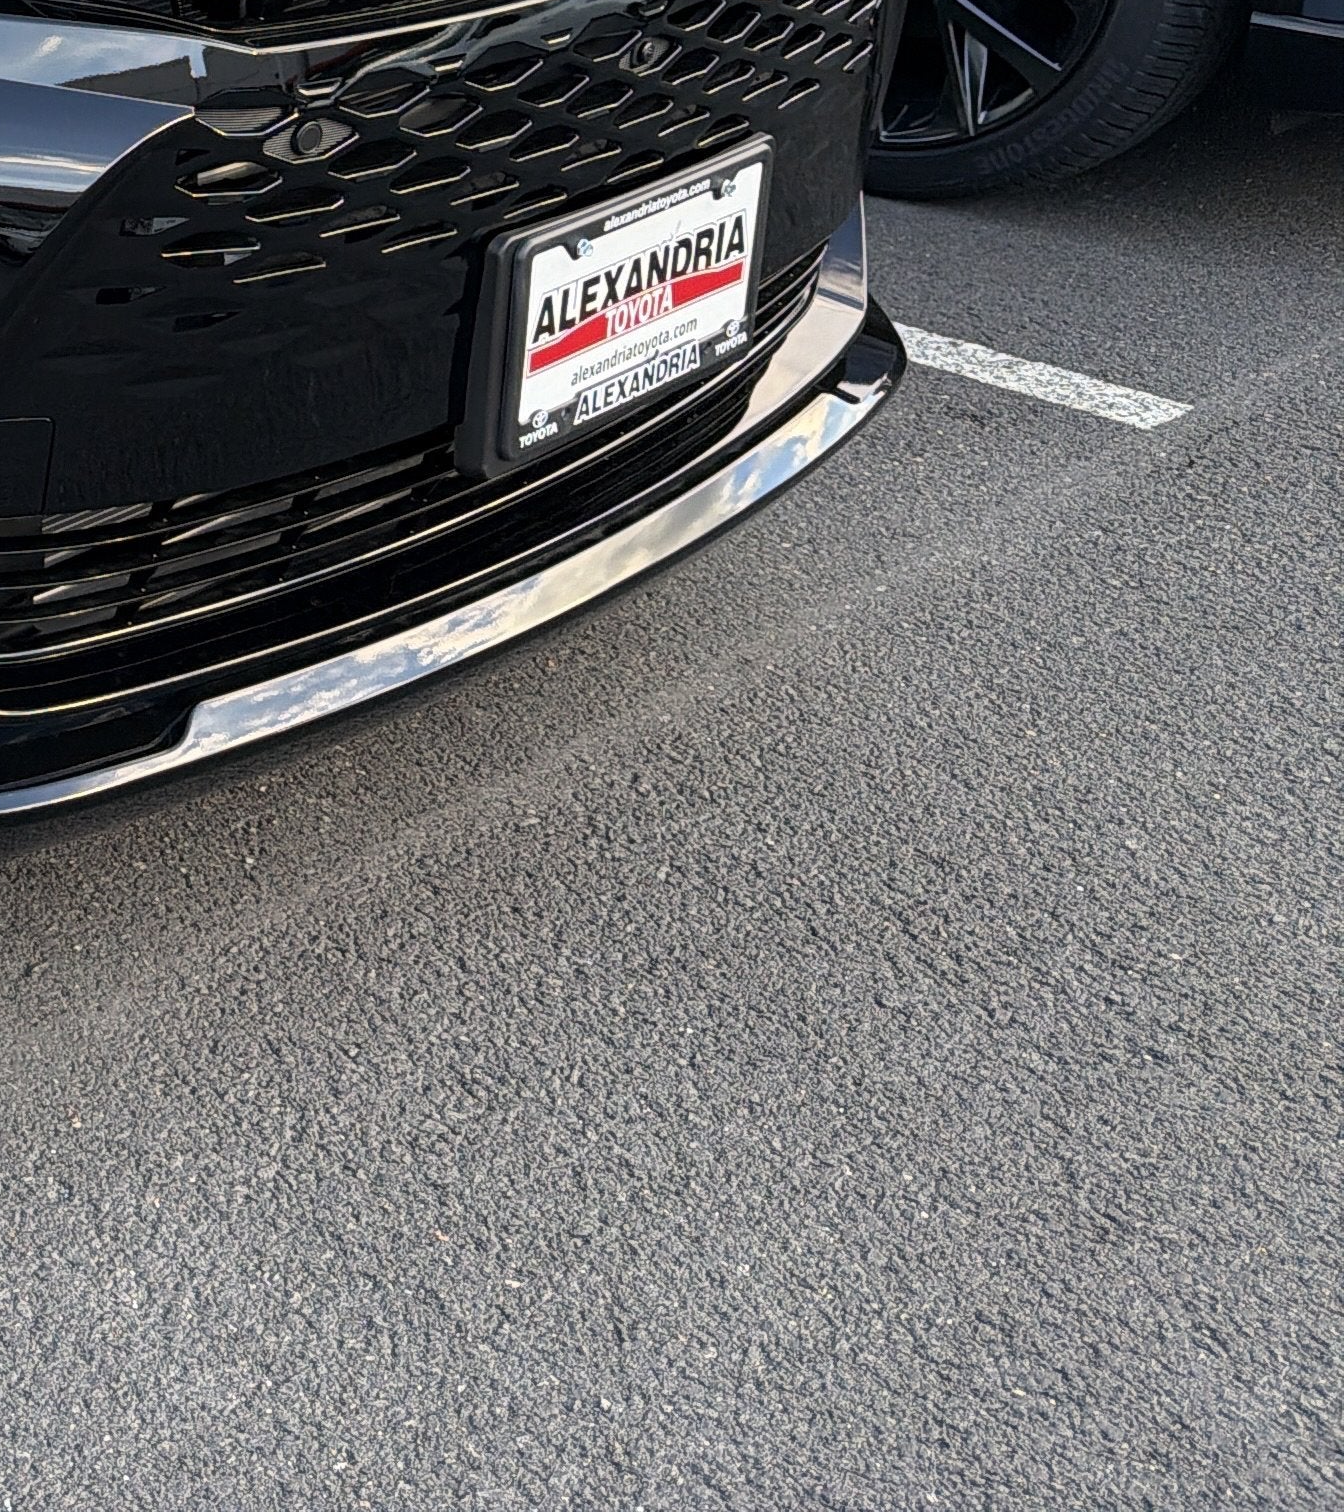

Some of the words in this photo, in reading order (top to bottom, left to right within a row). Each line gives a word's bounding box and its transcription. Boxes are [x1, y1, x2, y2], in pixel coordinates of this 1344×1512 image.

[603, 178, 711, 232] alexandriatoyota.com
[531, 214, 745, 345] ALEXANDRIA
[604, 285, 674, 339] TOYOTA
[570, 317, 698, 387] alexandriatoyota.com
[715, 330, 748, 357] TOYOTA
[574, 340, 701, 425] ALEXANDRIA
[518, 422, 559, 449] TOYOTA
